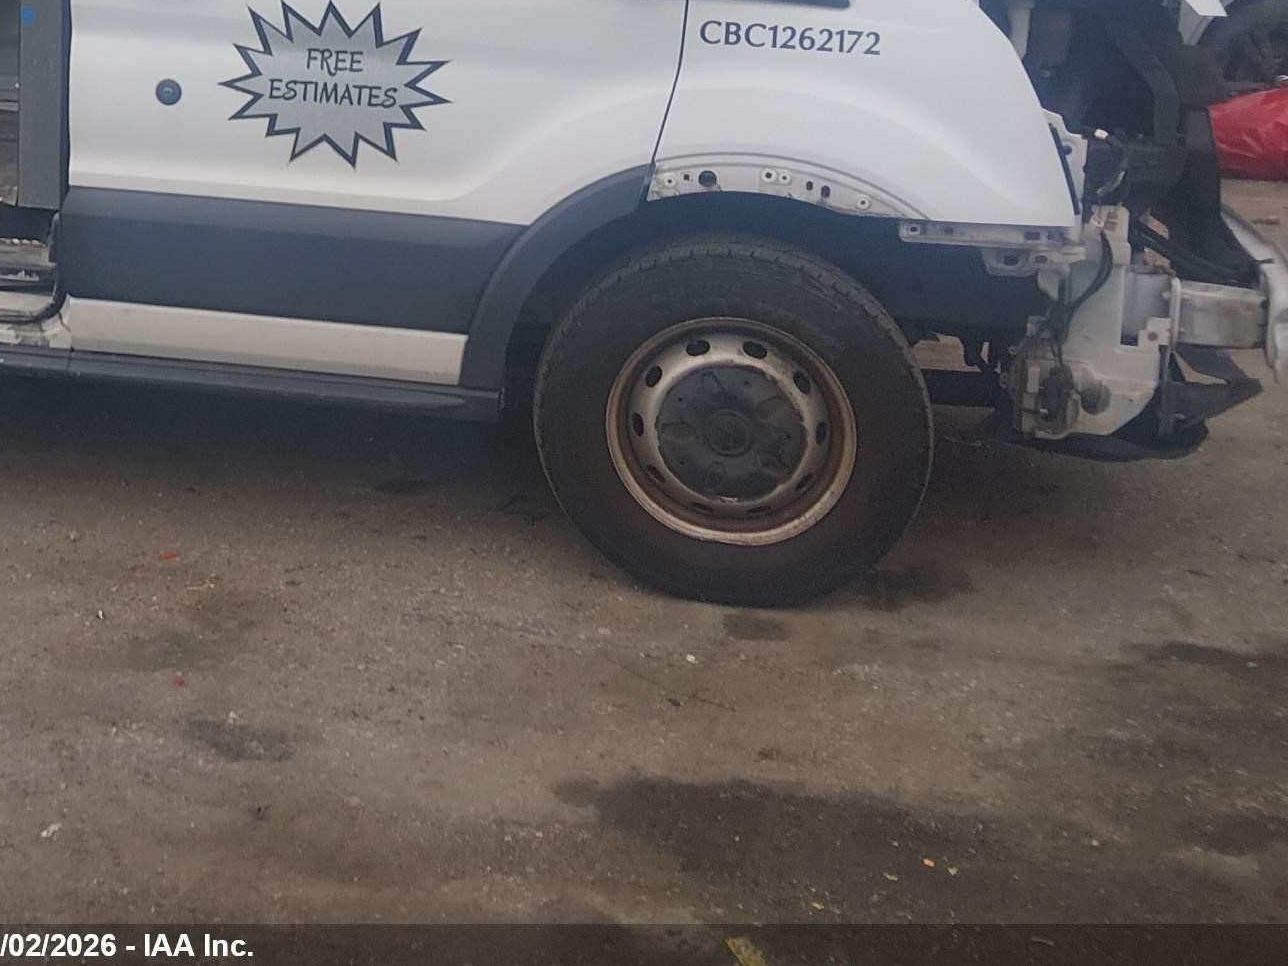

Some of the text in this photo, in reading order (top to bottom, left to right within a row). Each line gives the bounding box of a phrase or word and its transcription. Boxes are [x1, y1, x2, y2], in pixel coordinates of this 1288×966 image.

[699, 20, 881, 56] CBC1262172
[306, 47, 364, 76] FREE
[268, 78, 398, 109] ESTIMATES
